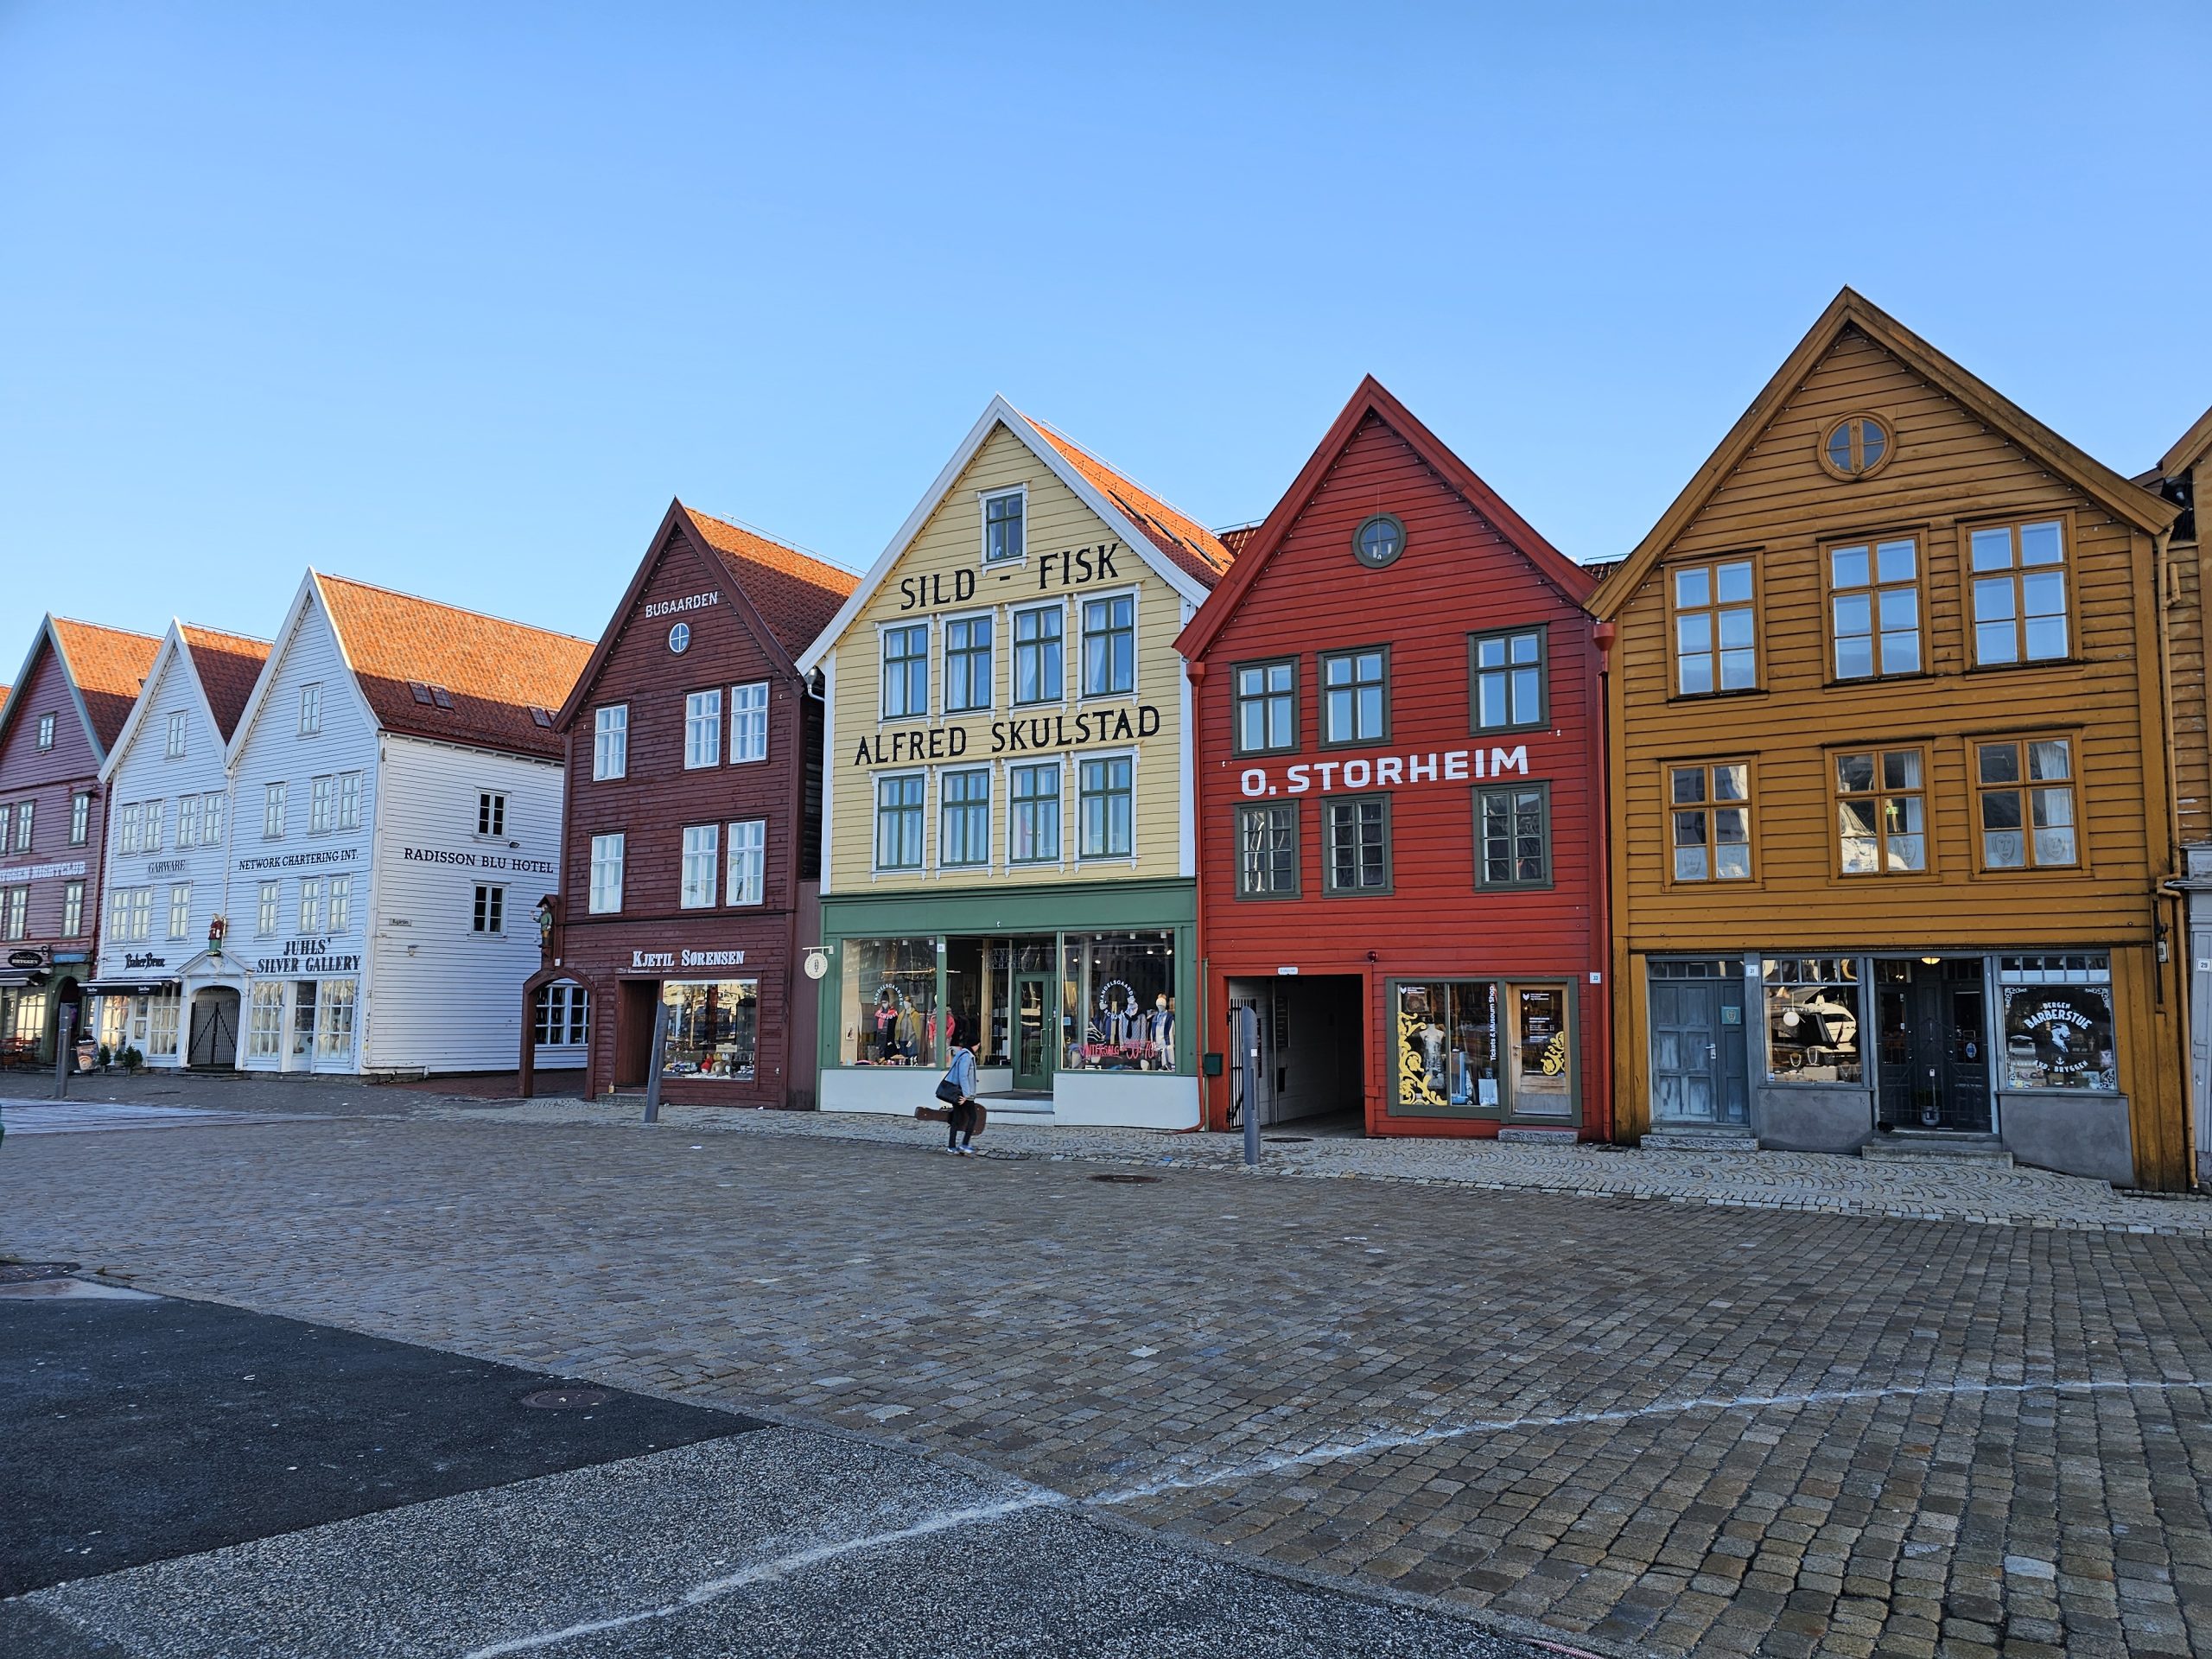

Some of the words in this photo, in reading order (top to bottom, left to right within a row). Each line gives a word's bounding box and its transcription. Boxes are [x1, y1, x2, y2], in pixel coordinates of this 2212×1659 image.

[899, 568, 976, 611] SILD
[1039, 543, 1119, 590] FISK
[645, 591, 718, 618] BUGAARDEN
[854, 727, 967, 766] ALFRED
[991, 705, 1160, 753] SKULSTAD
[1240, 768, 1277, 797] O.
[1287, 745, 1529, 793] STORHEIM
[148, 859, 186, 873] GARWARE
[238, 856, 282, 871] NETWORK
[282, 850, 339, 867] CHARTERING
[340, 849, 359, 861] INT.
[404, 847, 476, 866] RADISSON
[481, 855, 506, 869] BLU
[512, 859, 554, 874] HOTEL
[31, 861, 86, 880] NIGHTCLUB
[283, 938, 331, 956] JUHLS'
[257, 957, 299, 973] SILVER
[305, 955, 361, 972] GALLERY
[632, 950, 675, 967] KJETIL
[681, 949, 745, 966] SØRENSEN
[1488, 983, 1497, 1002] Shop
[2024, 1008, 2093, 1030] BARBERSTUE
[2054, 1059, 2088, 1073] BRYGGEN
